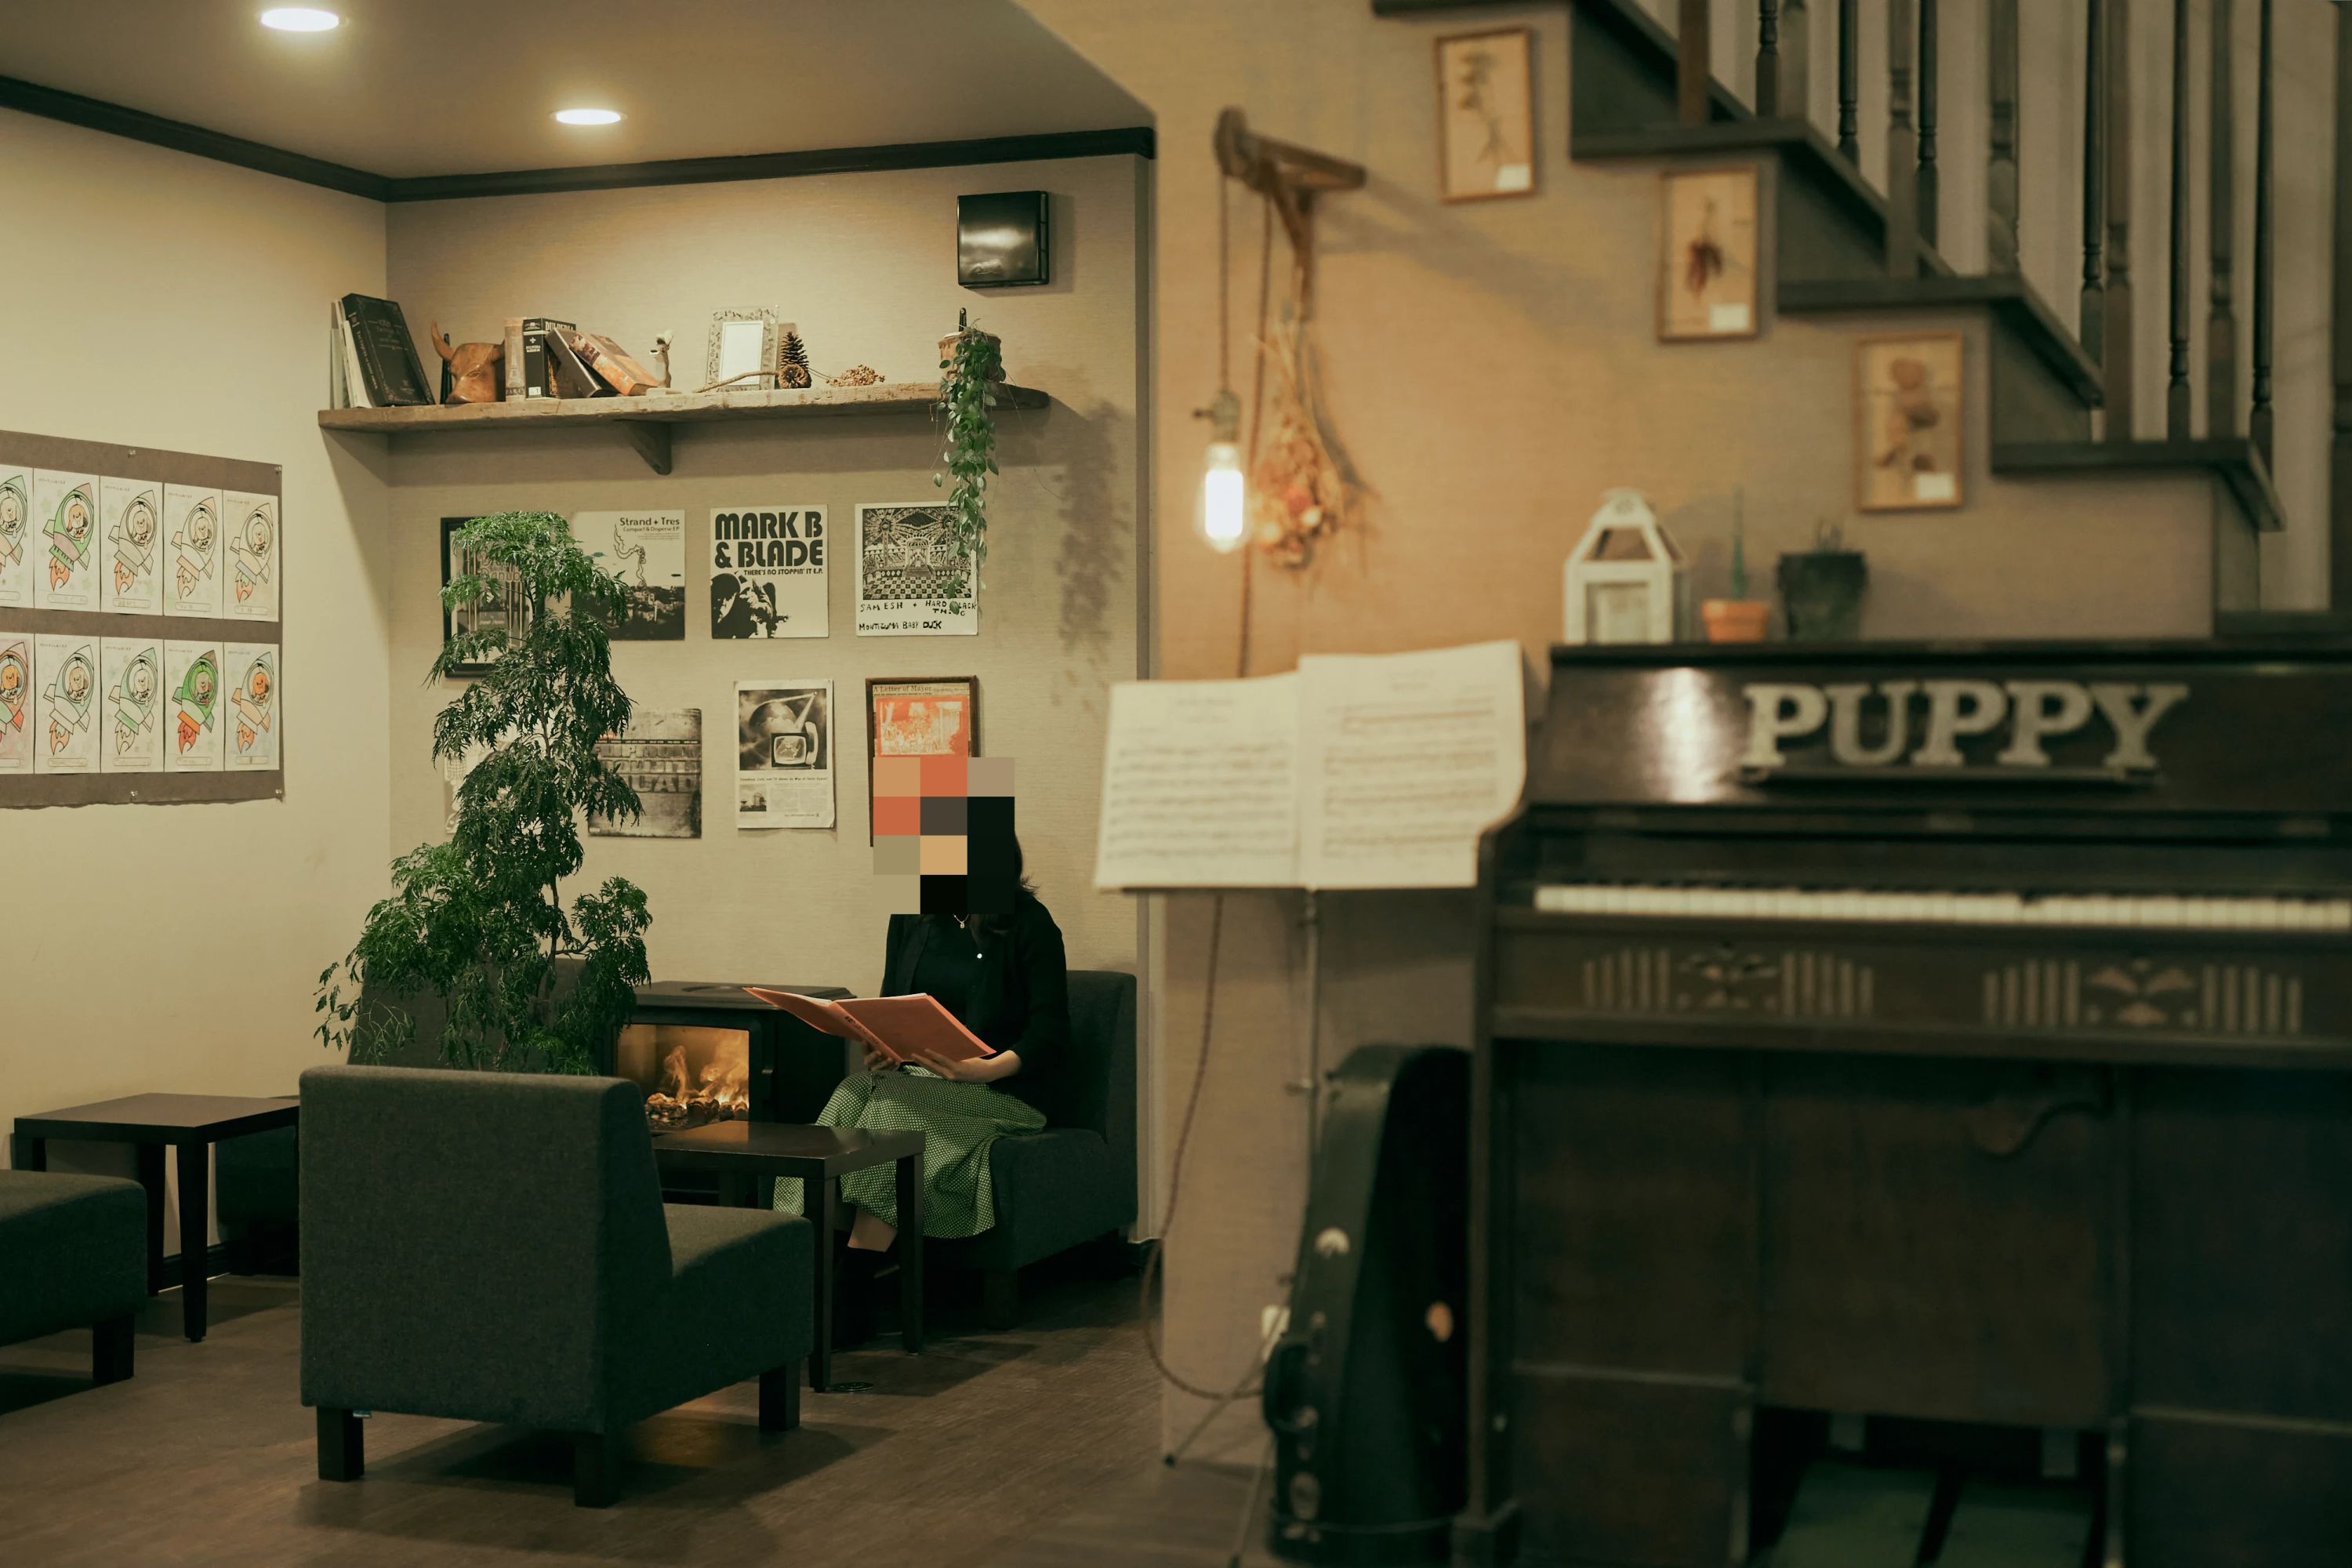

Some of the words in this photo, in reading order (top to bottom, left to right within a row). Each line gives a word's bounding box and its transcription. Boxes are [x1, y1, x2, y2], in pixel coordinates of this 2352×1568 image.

[661, 517, 680, 525] Tres
[715, 512, 799, 540] MARK
[805, 511, 822, 538] B
[715, 542, 732, 568] &
[738, 539, 823, 568] BLADE
[1740, 679, 2190, 769] PUPPY
